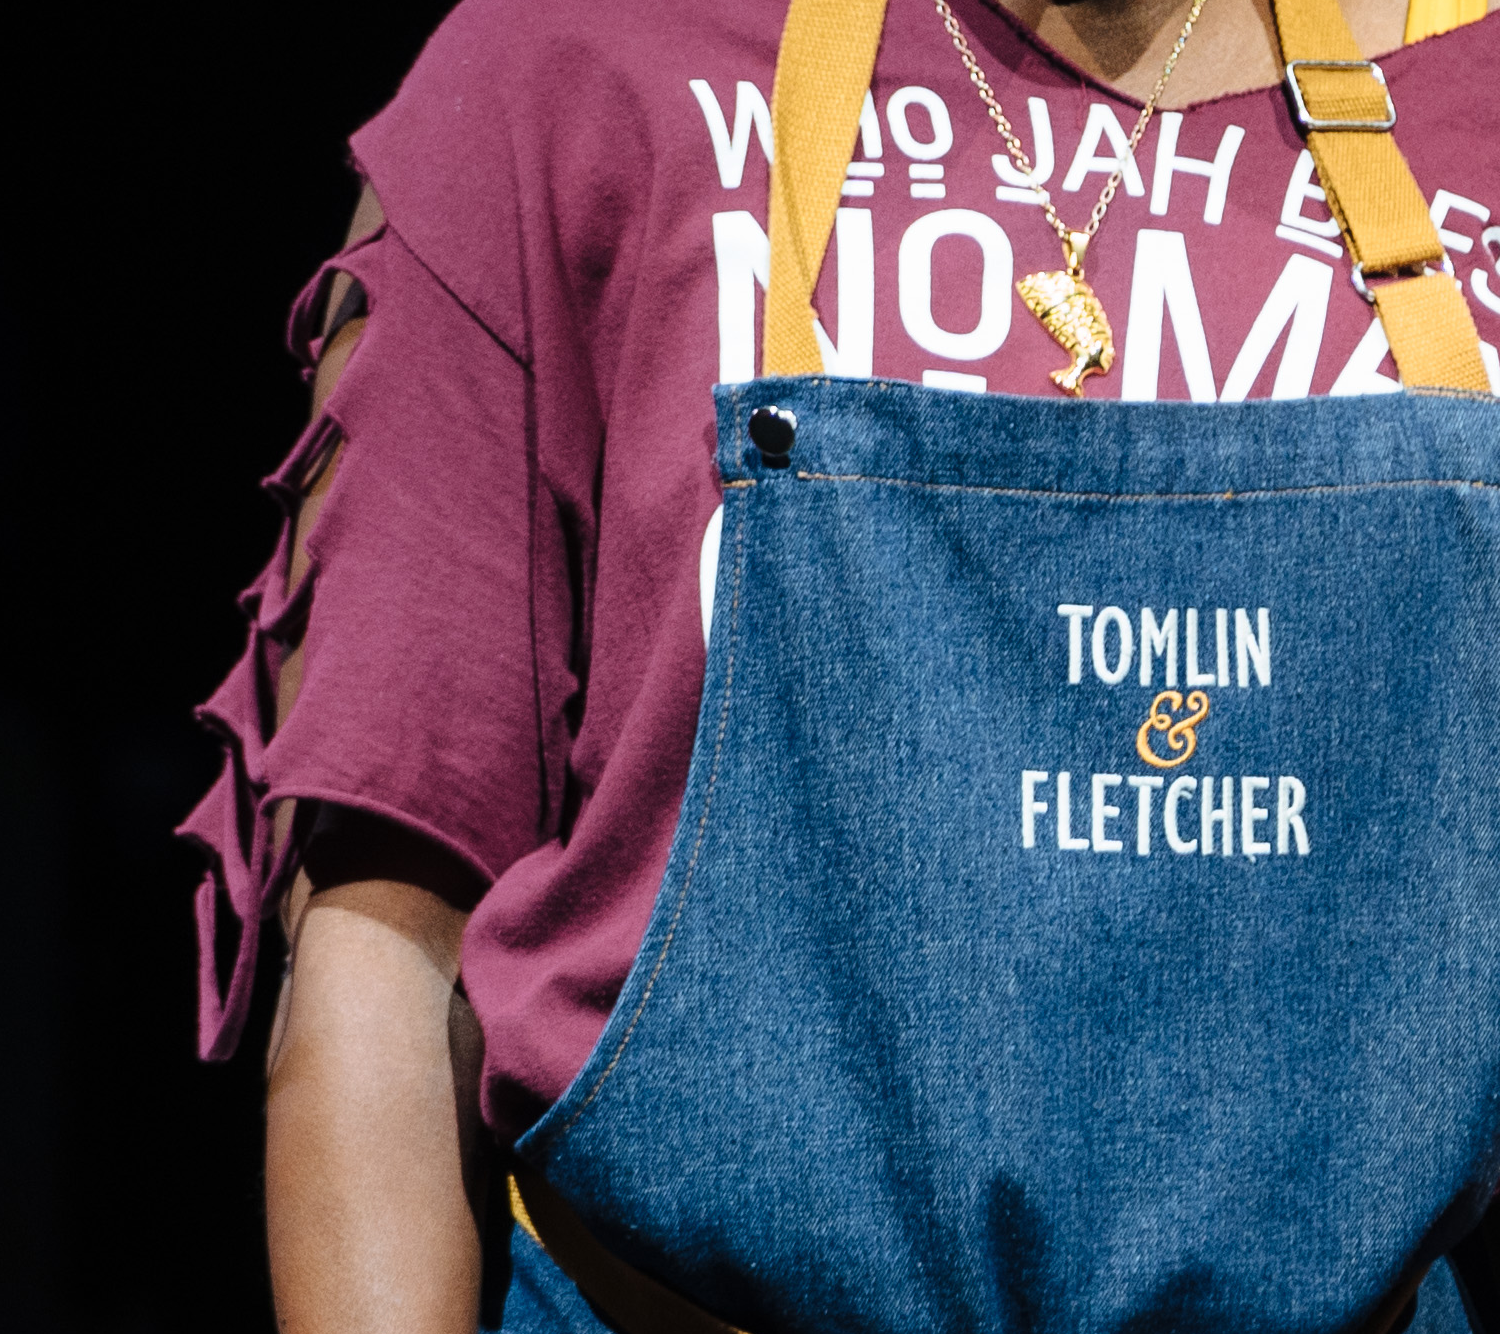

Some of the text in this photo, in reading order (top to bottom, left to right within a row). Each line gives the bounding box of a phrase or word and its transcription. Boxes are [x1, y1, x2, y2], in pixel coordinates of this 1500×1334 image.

[991, 96, 1245, 225] JAH
[712, 208, 1014, 385] NO
[1057, 604, 1271, 688] TOMLIN
[1136, 690, 1210, 768] &
[1021, 769, 1310, 857] FLETCHER
